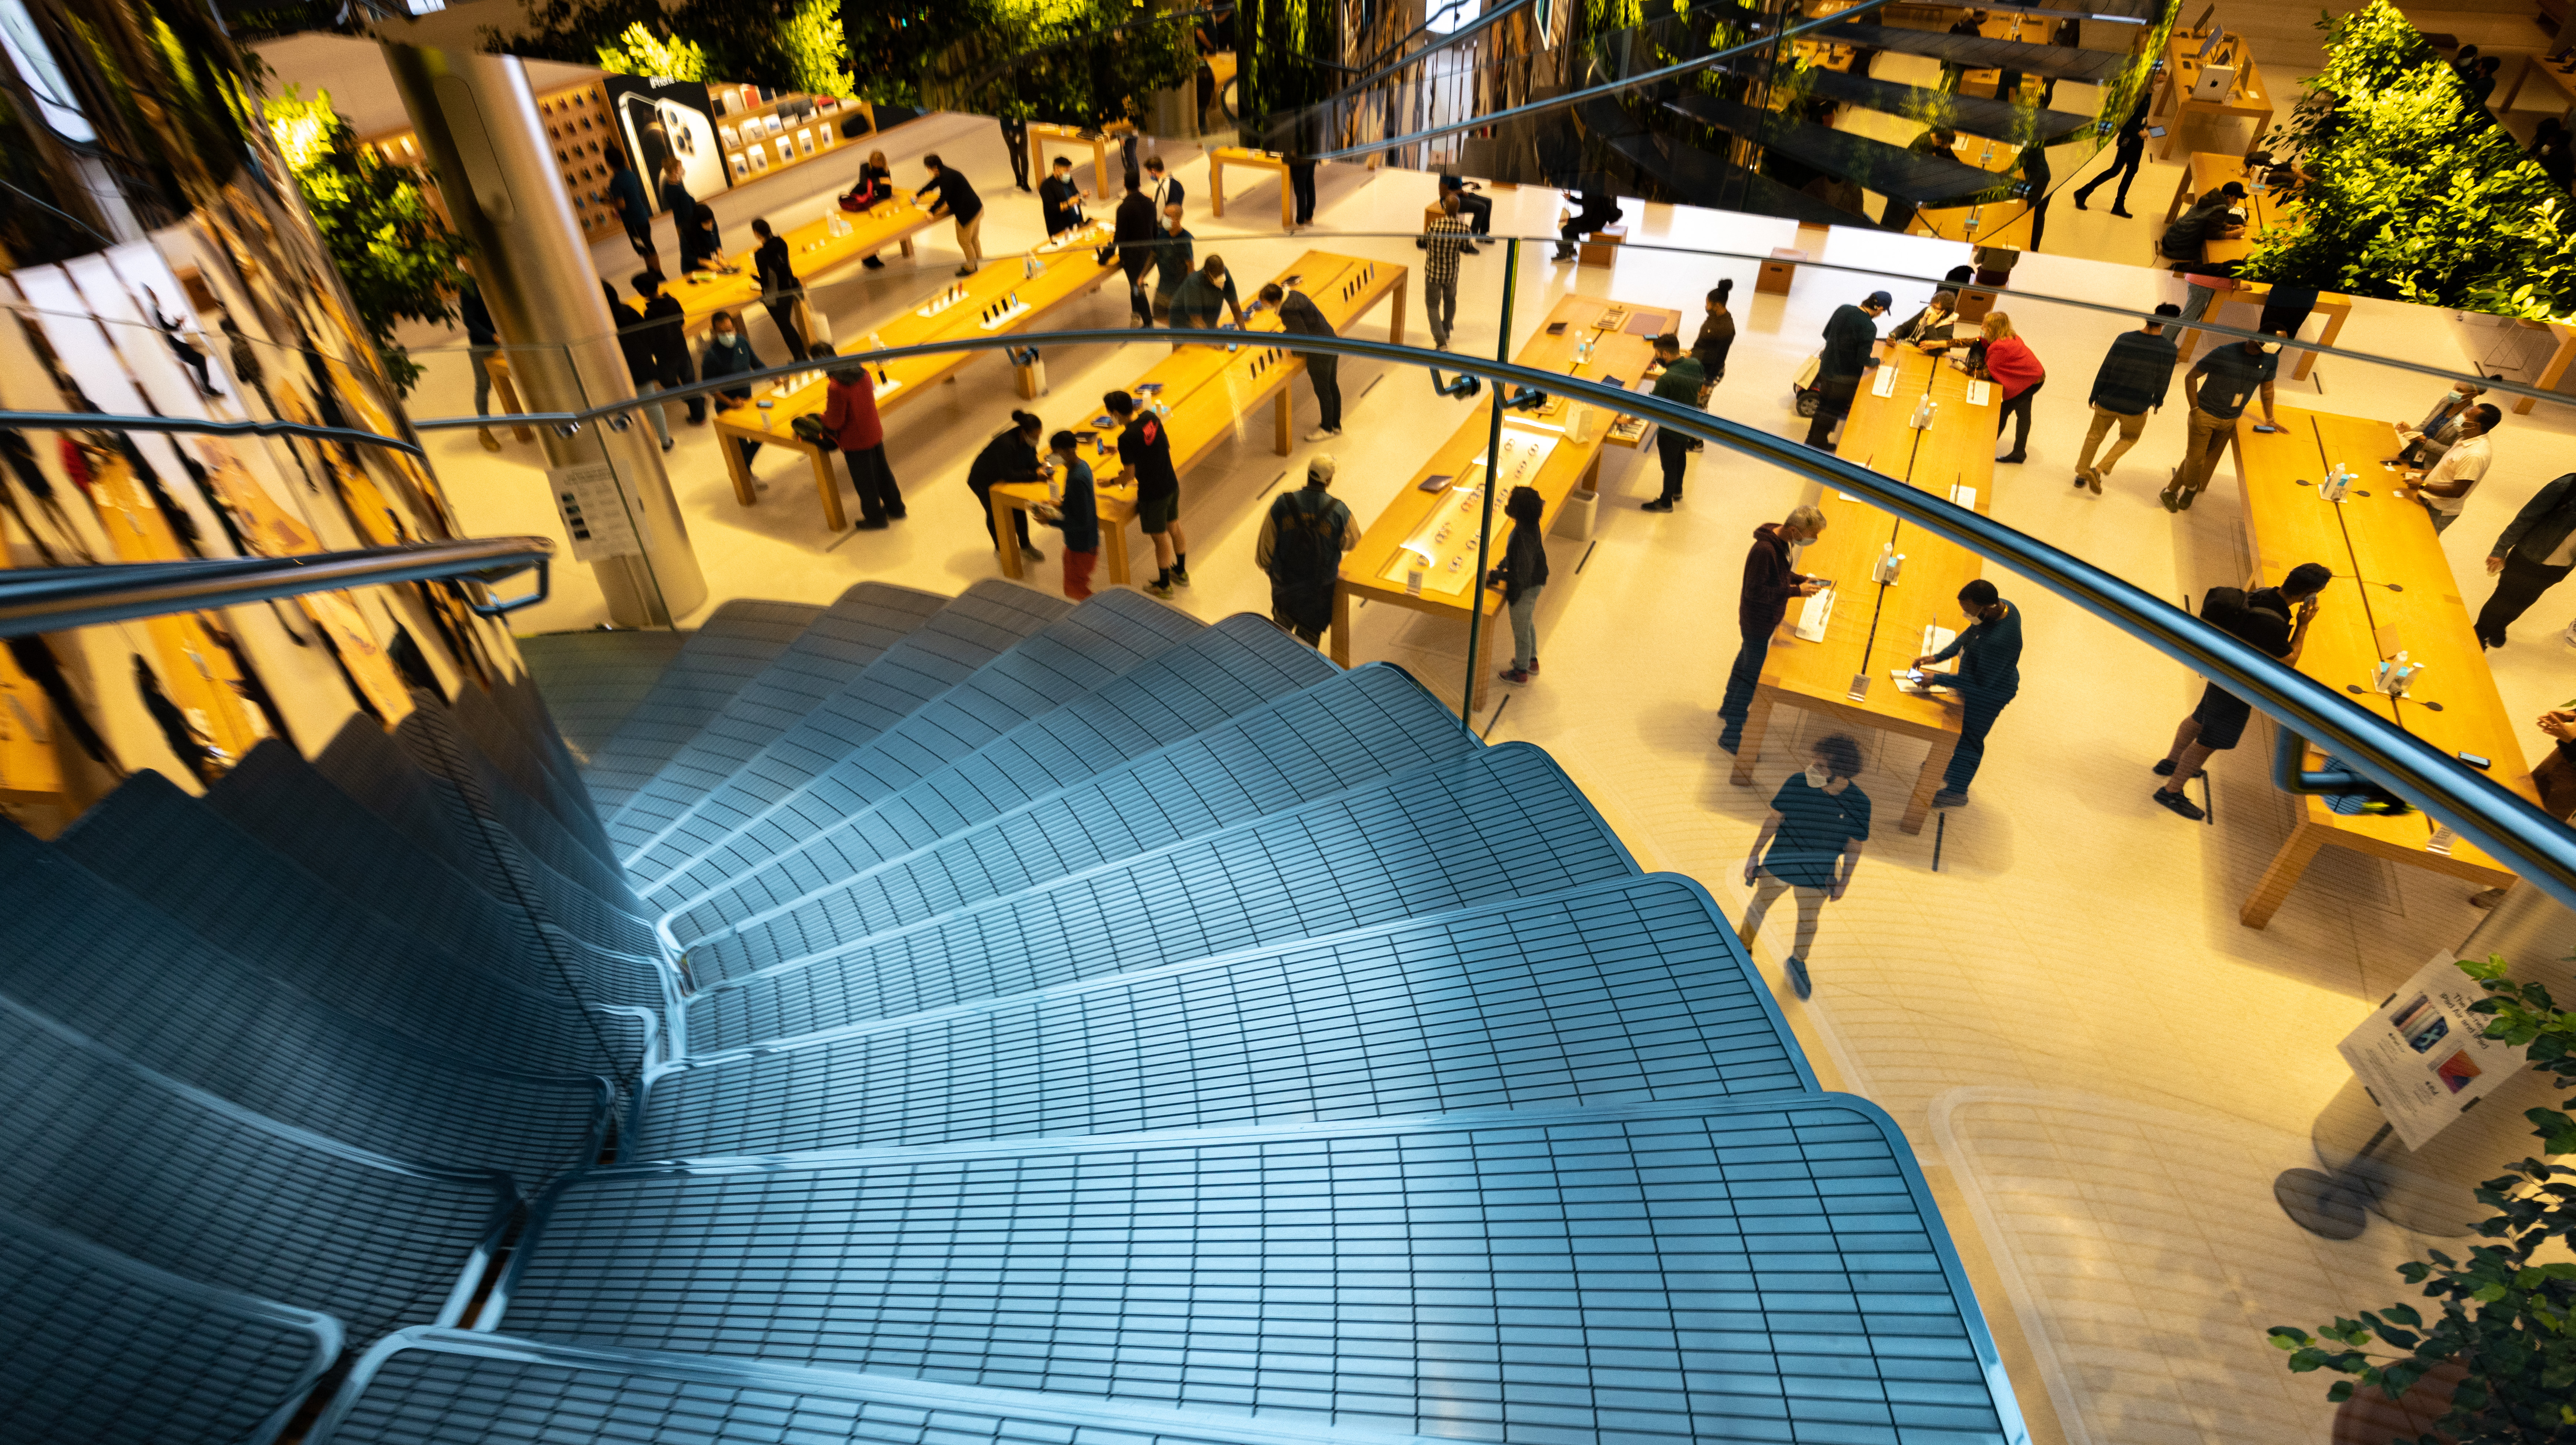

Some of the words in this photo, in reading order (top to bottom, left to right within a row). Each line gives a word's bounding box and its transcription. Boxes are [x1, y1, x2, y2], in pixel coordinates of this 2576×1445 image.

[2440, 992, 2455, 1009] iPad
[2452, 1009, 2463, 1019] Air
[2461, 1020, 2475, 1034] and
[2453, 992, 2466, 1008] The
